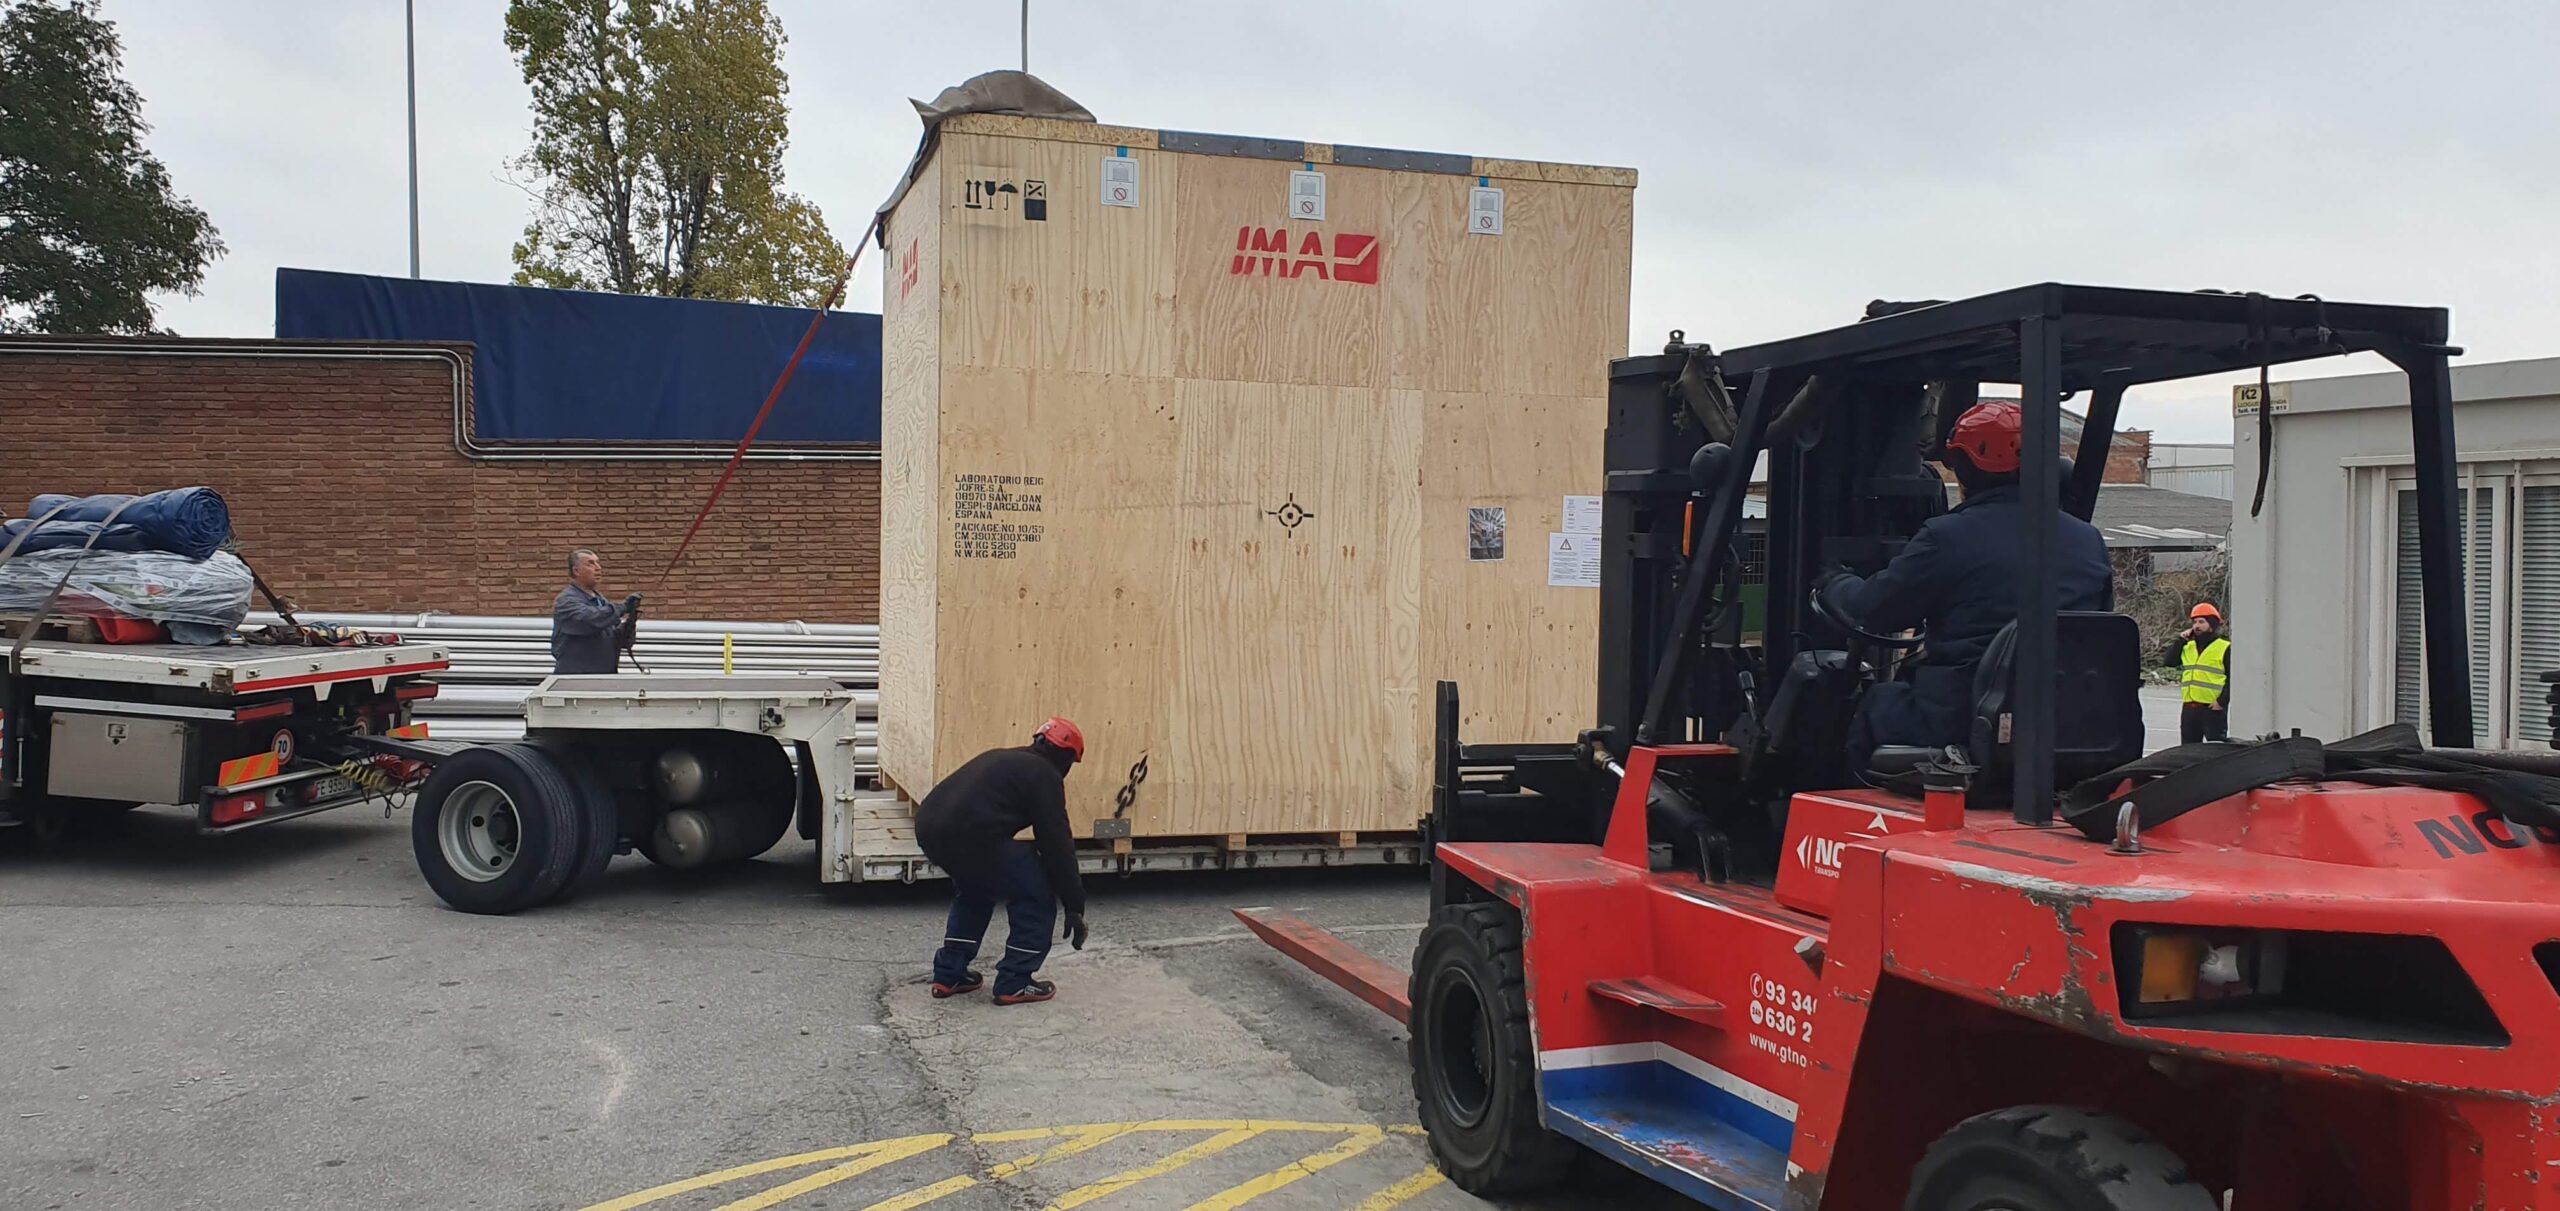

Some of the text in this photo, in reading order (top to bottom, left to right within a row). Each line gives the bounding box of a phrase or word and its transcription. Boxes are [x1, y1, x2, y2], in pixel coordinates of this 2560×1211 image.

[1231, 226, 1329, 280] IMA
[2241, 388, 2257, 400] K2
[955, 474, 1044, 486] LABORATORIO REIG
[956, 484, 985, 492] JOFRE
[955, 492, 1042, 503] 08970 SANT JOAN
[955, 510, 992, 520] ESPANA
[1018, 525, 1044, 534] 10/53
[954, 532, 969, 540] CM
[991, 542, 1016, 550] 5260
[991, 550, 1016, 559] 4200
[278, 740, 288, 753] 70
[1765, 980, 1818, 1015] 93 34
[1802, 1022, 1812, 1043] 2
